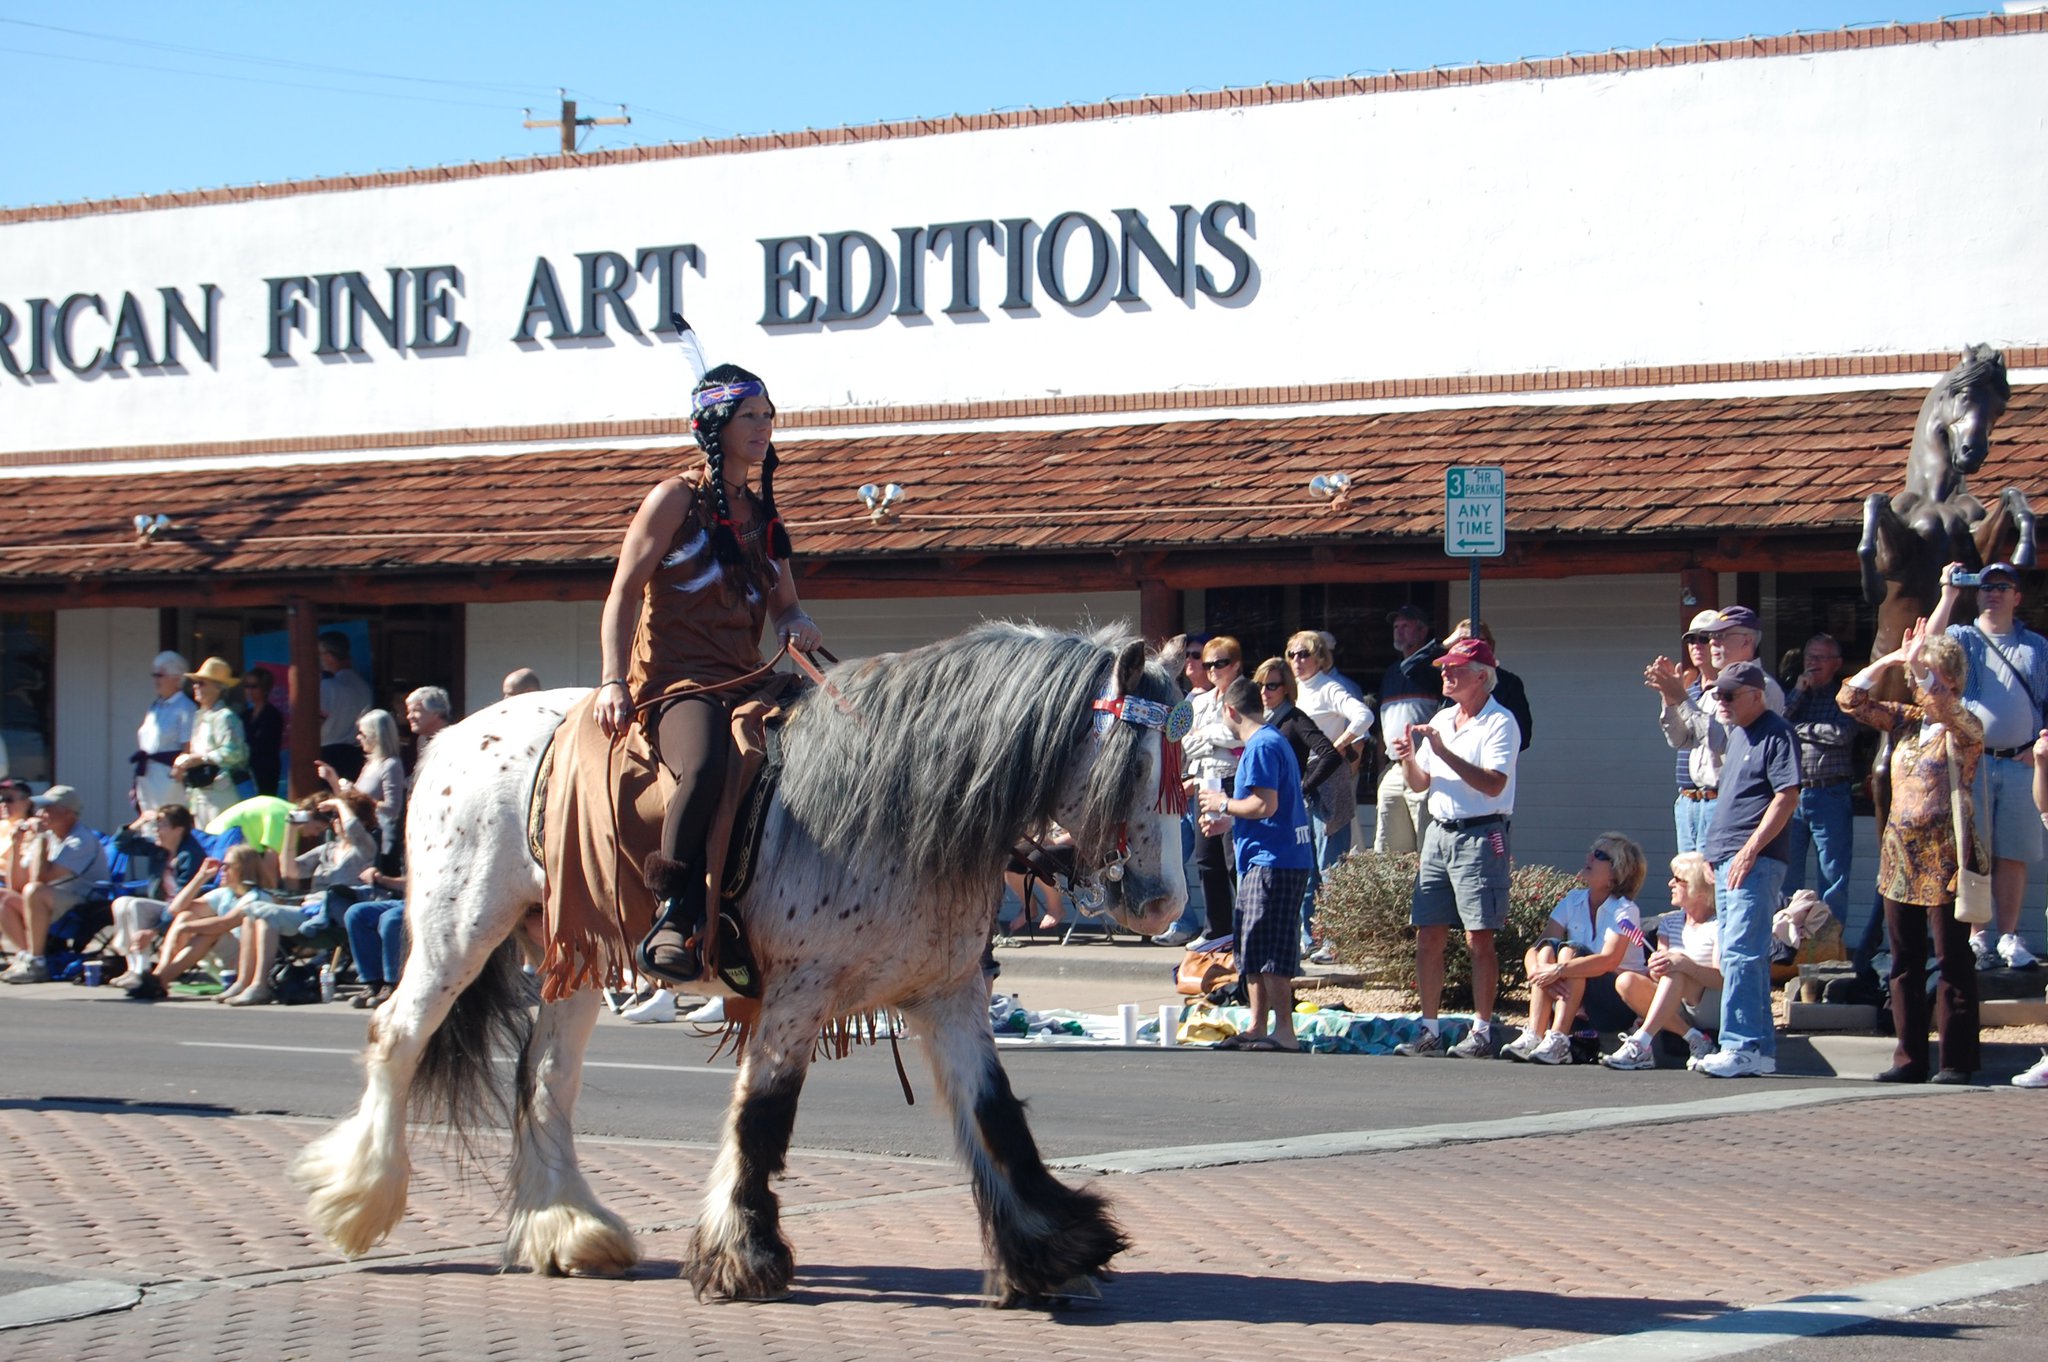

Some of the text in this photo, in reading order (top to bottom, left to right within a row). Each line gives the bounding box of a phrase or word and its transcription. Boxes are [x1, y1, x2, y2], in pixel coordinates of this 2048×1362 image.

[263, 265, 467, 359] FINE
[511, 244, 698, 343] ART
[755, 199, 1250, 326] EDITIONS
[1450, 472, 1492, 496] 3 HR
[1466, 484, 1500, 495] PARKING
[1458, 503, 1492, 517] ANY
[1456, 521, 1493, 535] TIME
